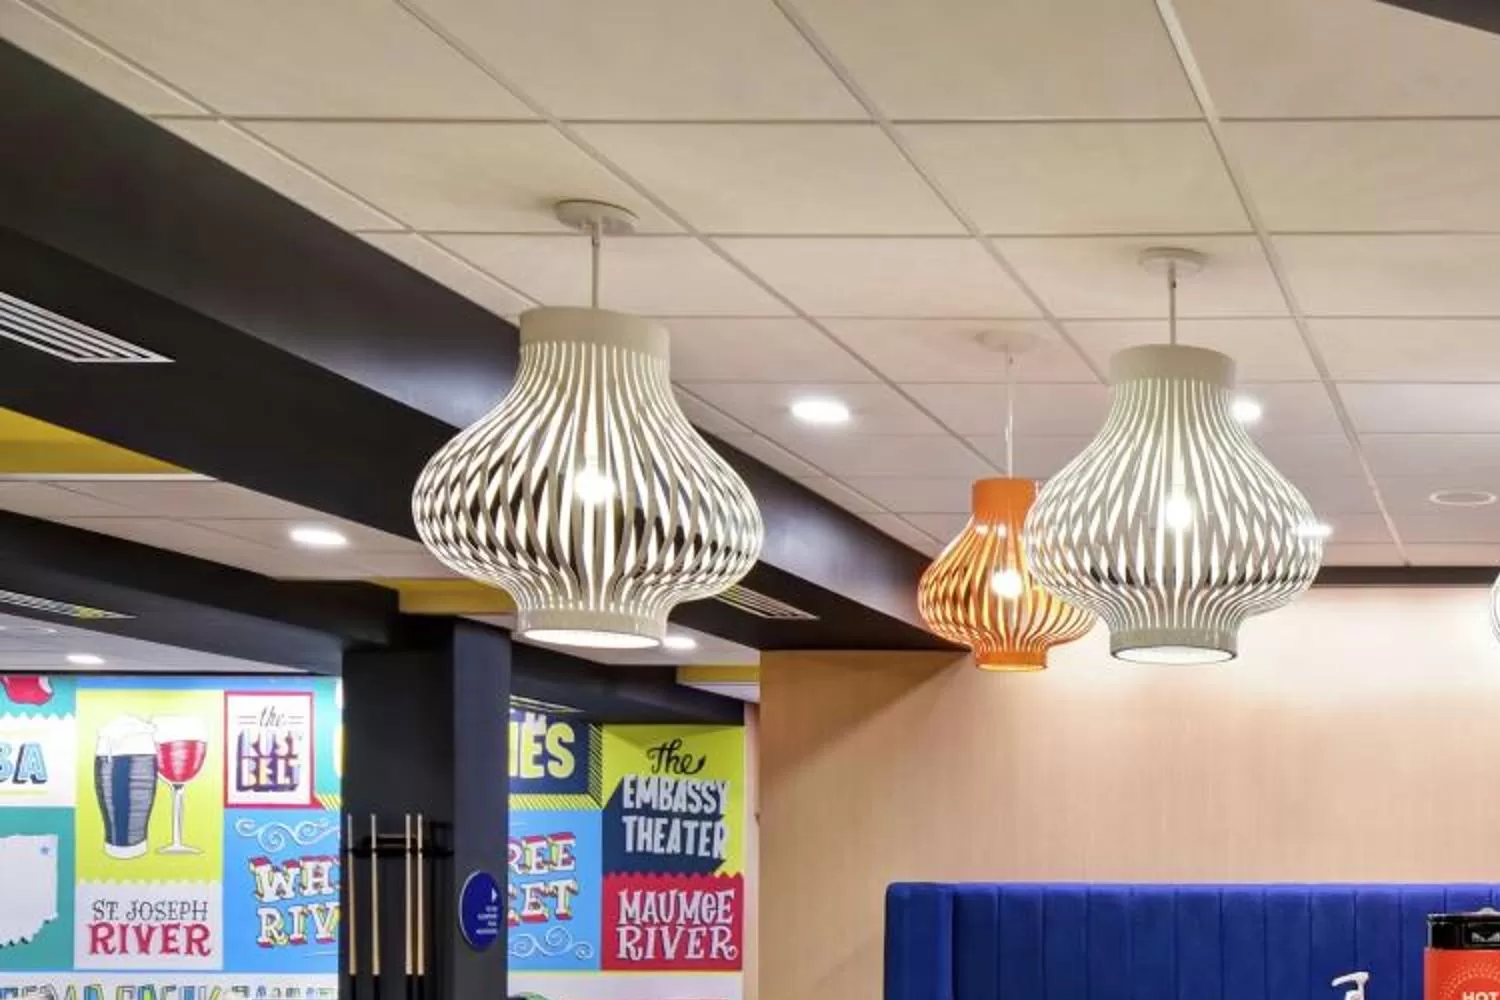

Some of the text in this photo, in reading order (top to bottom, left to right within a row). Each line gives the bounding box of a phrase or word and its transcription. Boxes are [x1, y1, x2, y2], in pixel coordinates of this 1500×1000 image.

[237, 728, 304, 758] RUST
[647, 738, 707, 776] The
[236, 757, 301, 792] BELT
[621, 774, 730, 817] EMBASSY
[621, 814, 730, 860] THEATER
[248, 854, 340, 903] WH
[92, 899, 209, 921] ST. JOSEPH
[256, 901, 341, 949] RIV
[88, 921, 211, 957] RIVER
[616, 923, 738, 961] RIVER
